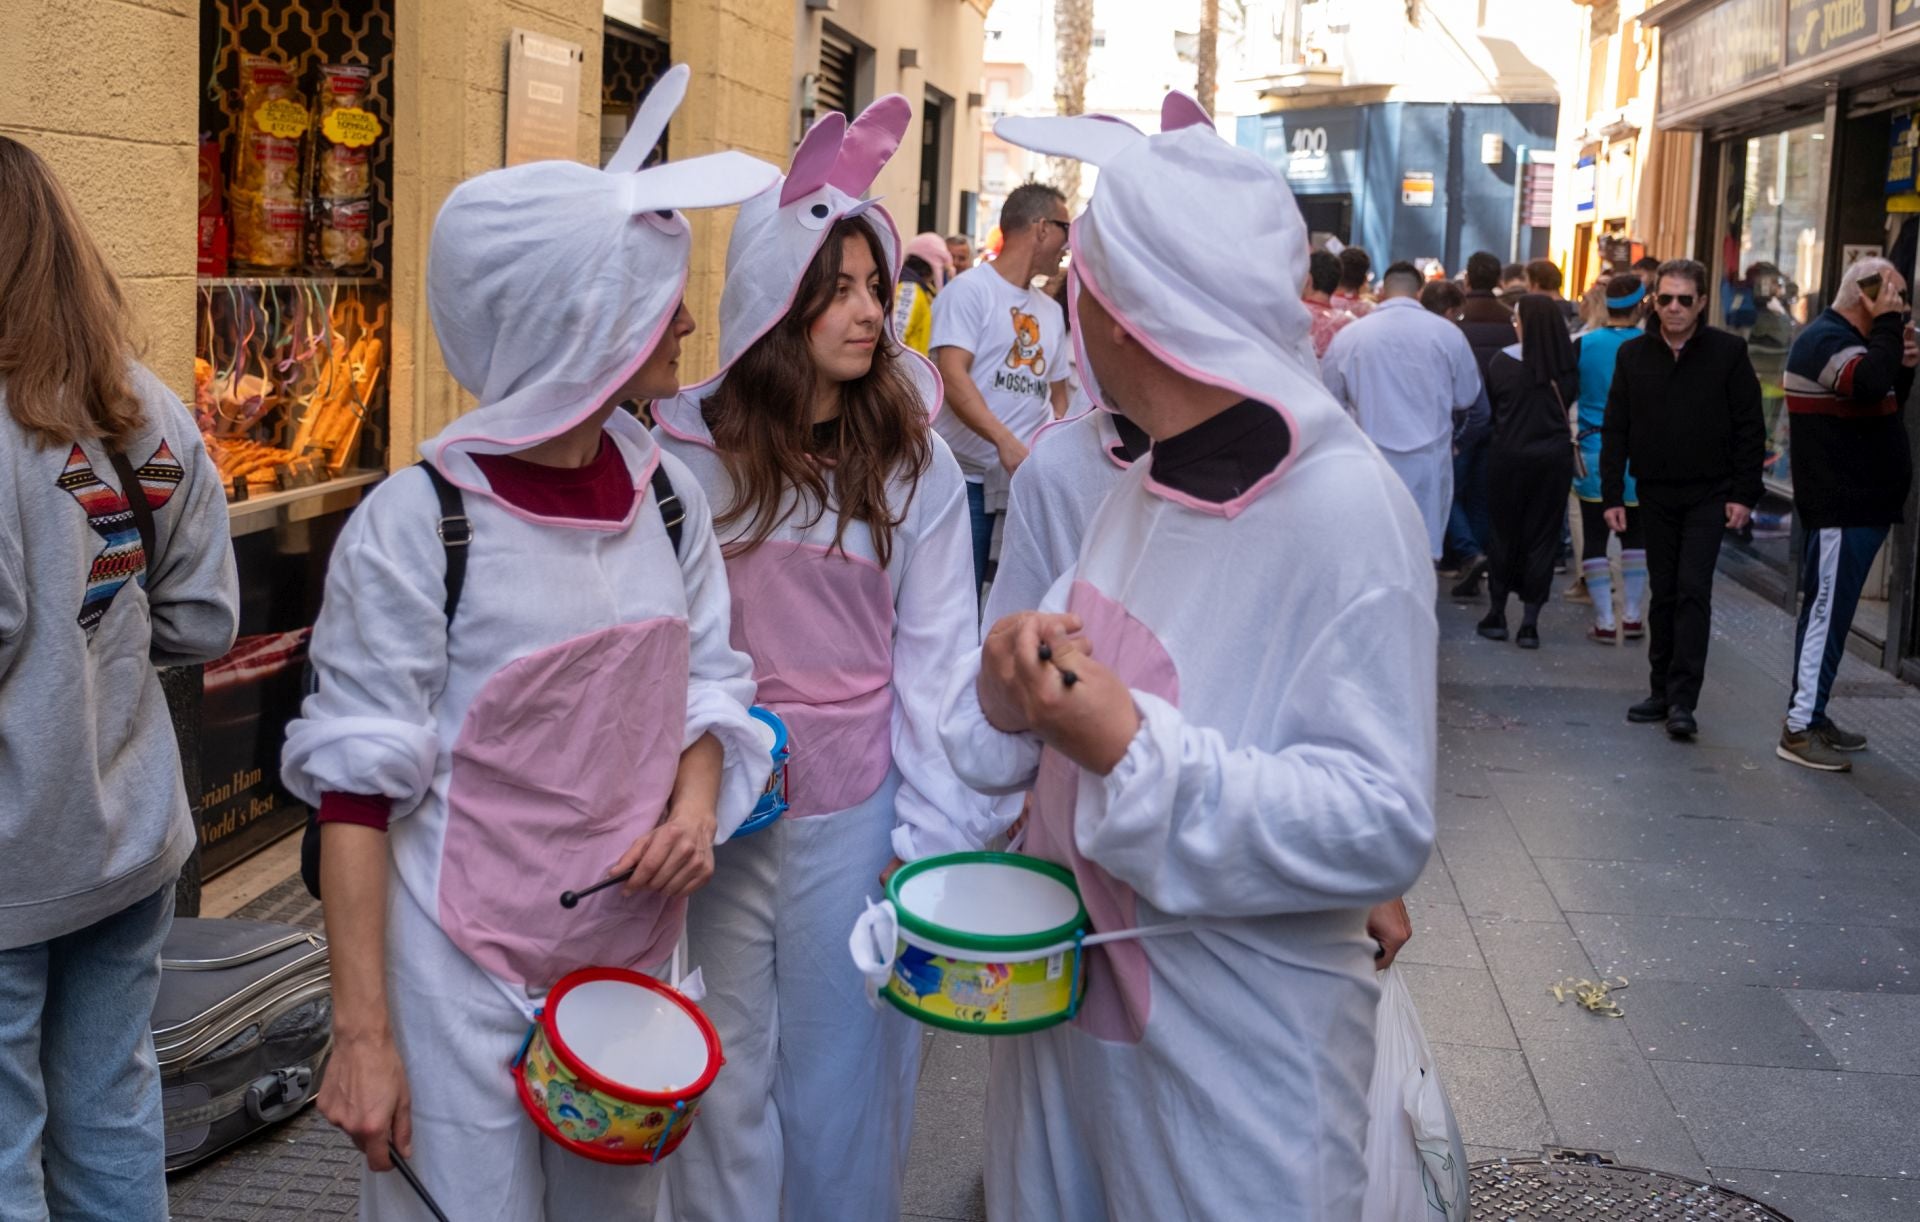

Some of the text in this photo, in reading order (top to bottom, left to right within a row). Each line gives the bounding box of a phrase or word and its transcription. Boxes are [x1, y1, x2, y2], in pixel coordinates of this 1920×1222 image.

[1291, 127, 1327, 158] 100
[994, 369, 1047, 401] MOSCHIN
[233, 768, 261, 795] Ham
[250, 793, 274, 821] Best
